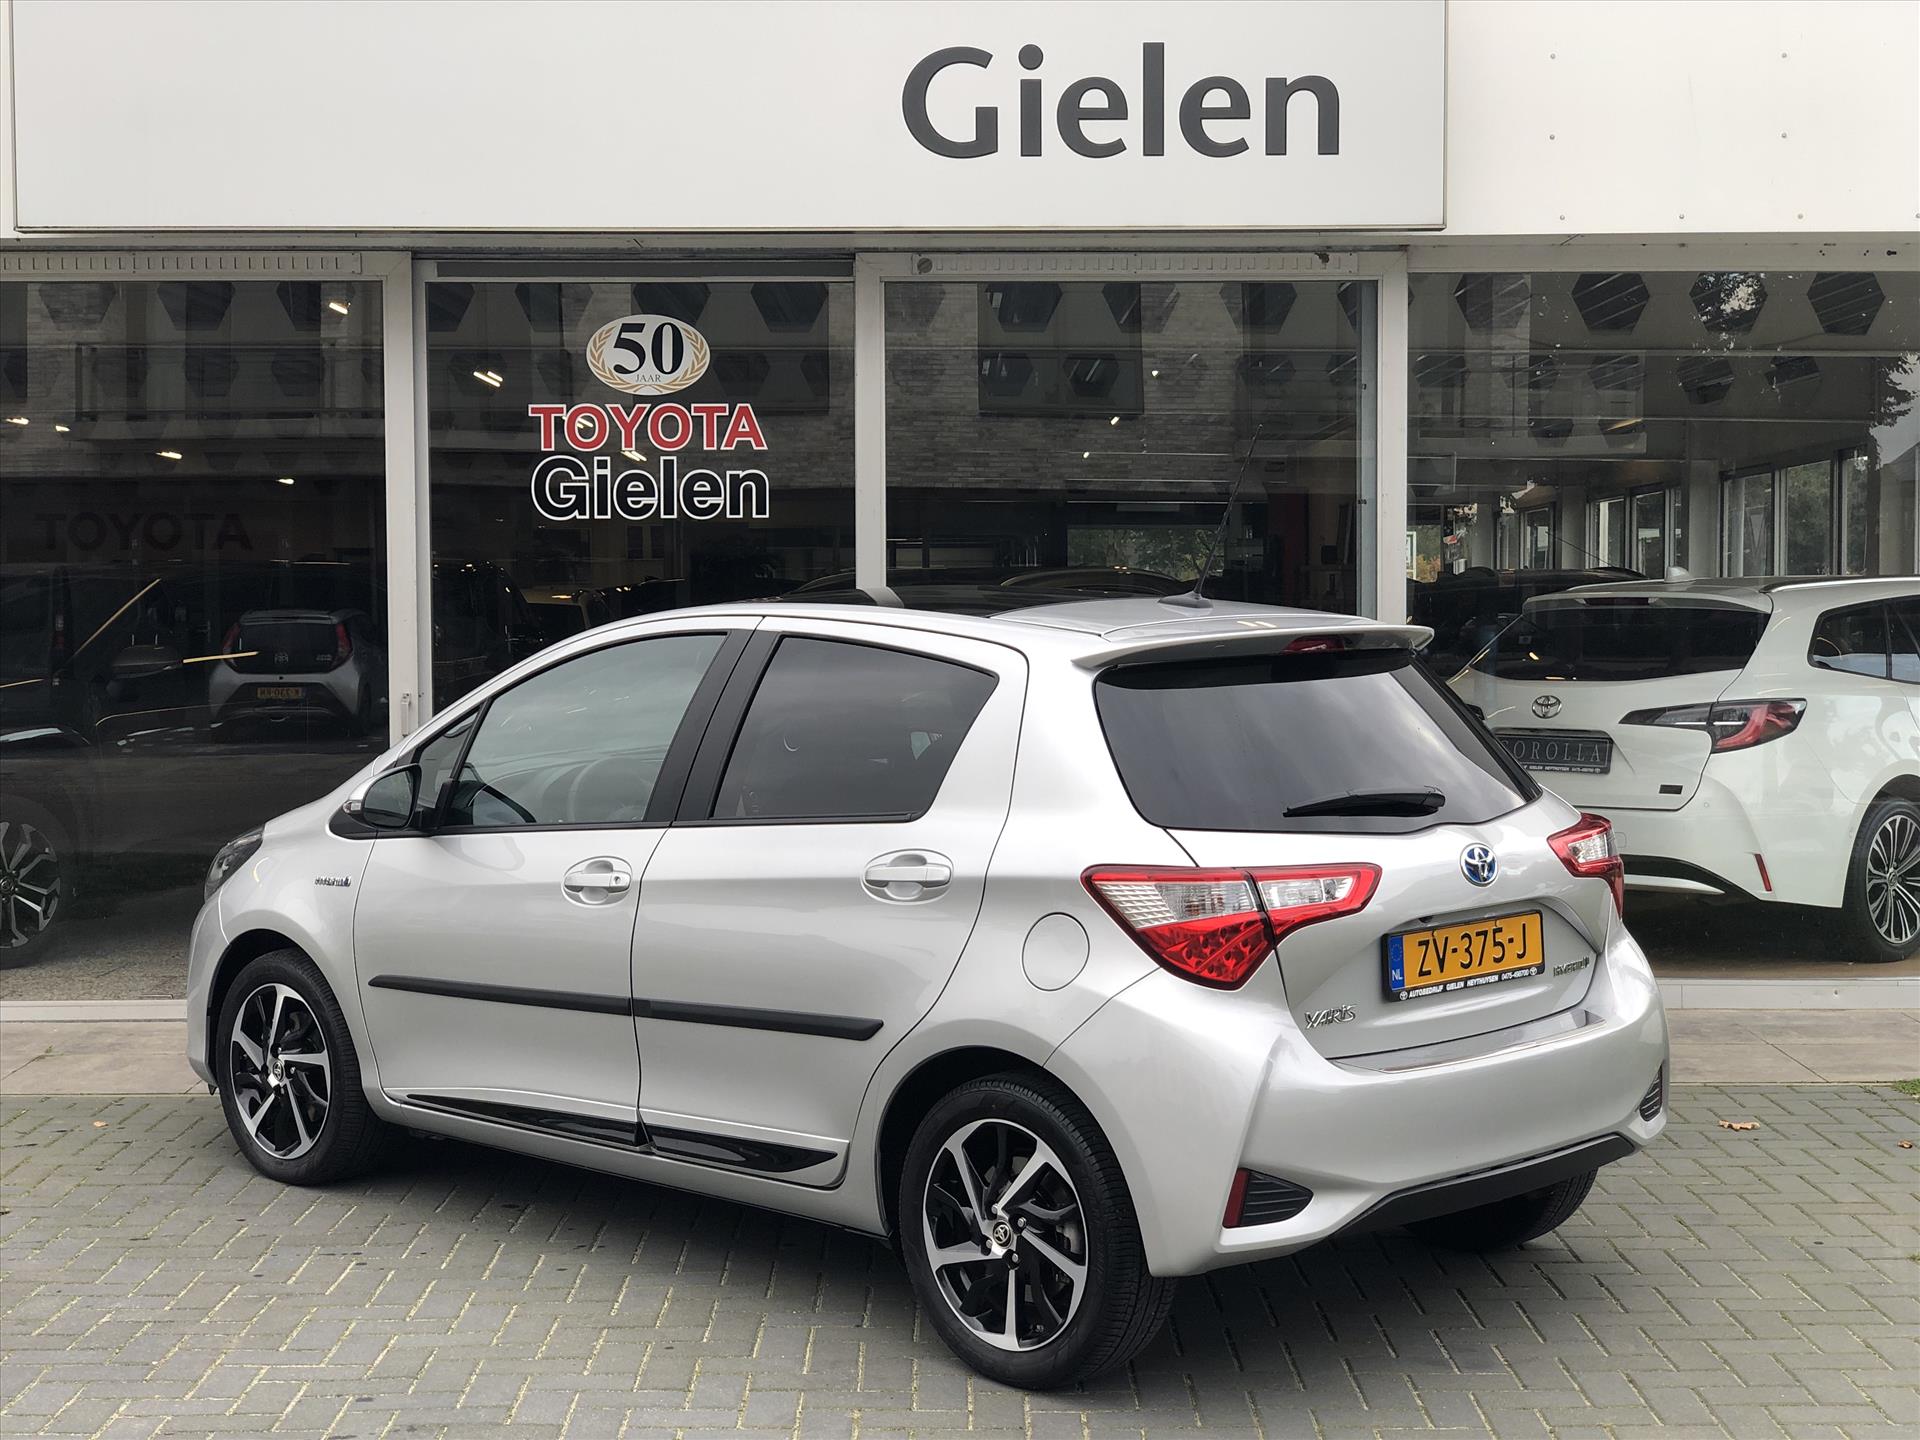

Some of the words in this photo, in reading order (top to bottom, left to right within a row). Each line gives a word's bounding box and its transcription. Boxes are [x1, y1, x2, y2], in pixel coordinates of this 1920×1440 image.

[902, 43, 1340, 159] Gielen
[612, 322, 684, 375] 50
[635, 373, 662, 383] JAAR
[528, 403, 768, 451] TOYOTA
[531, 455, 770, 521] Gielen
[34, 512, 254, 551] TOYOTA
[1418, 923, 1528, 978] ZV-375-J
[1391, 969, 1404, 981] NL
[1408, 984, 1444, 998] AUTOBEDRIJF
[1446, 980, 1465, 991] GIELEN
[1467, 974, 1499, 987] HEYTHUYSEN
[1304, 1004, 1357, 1029] YARIS
